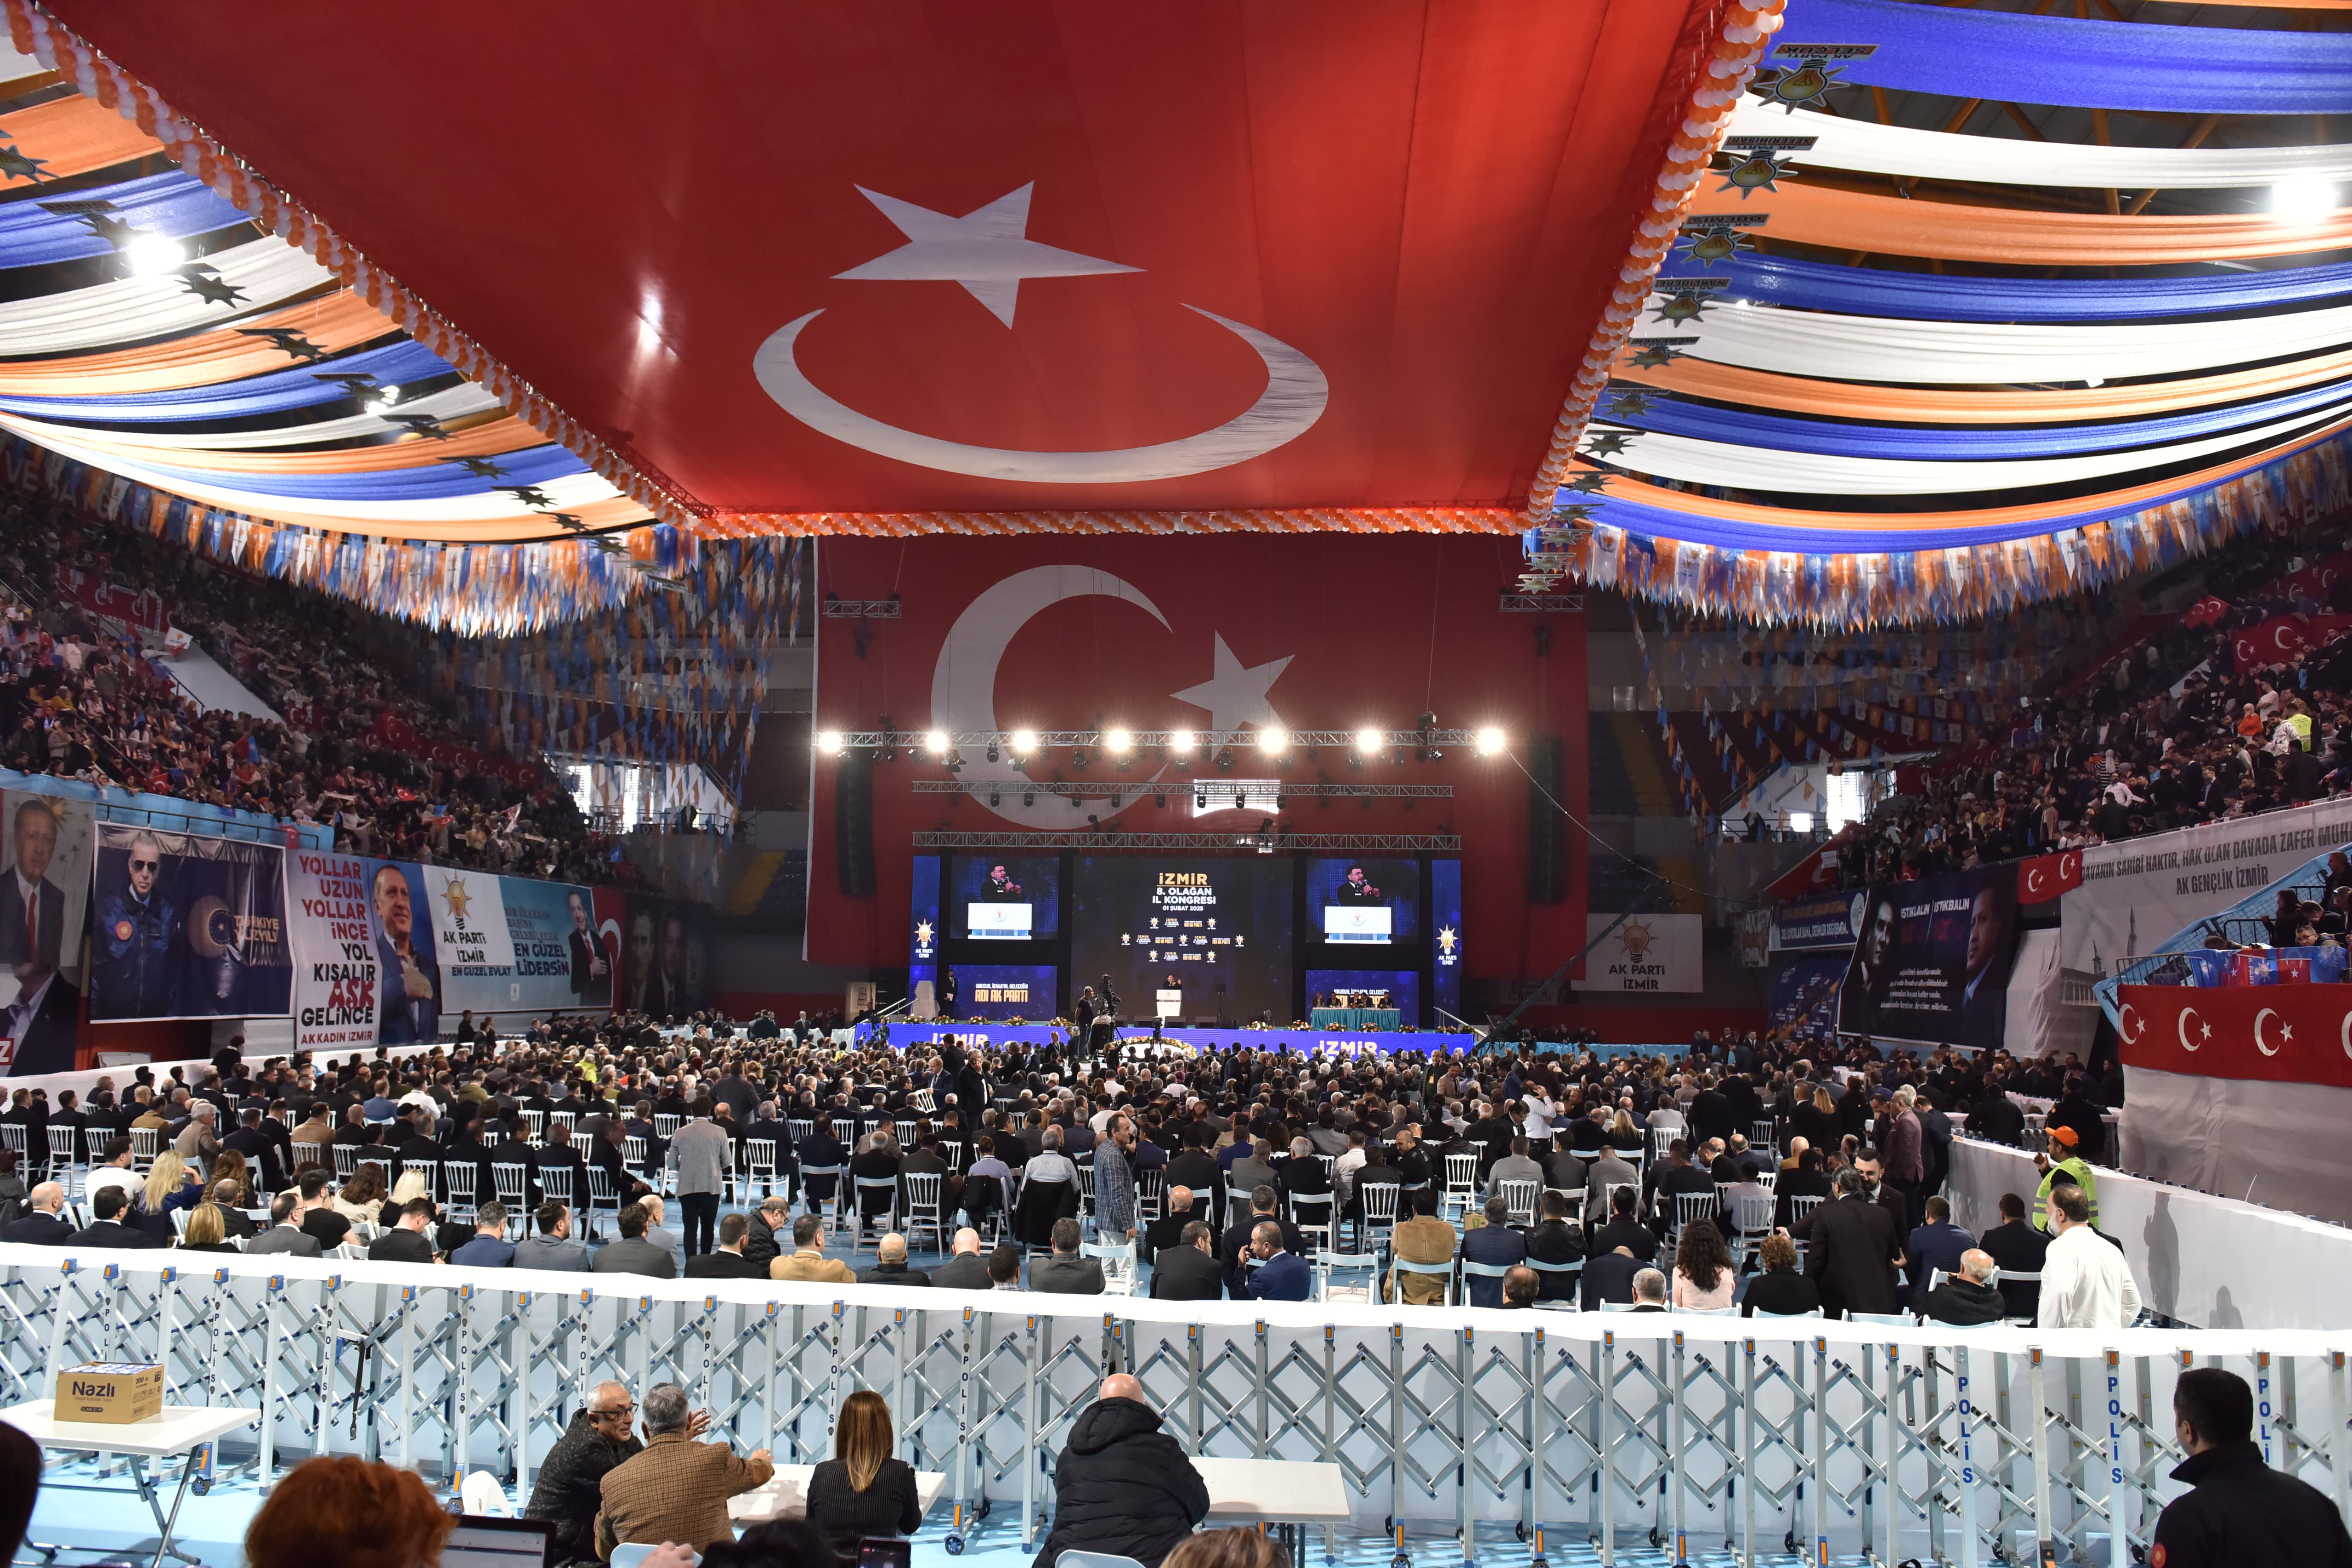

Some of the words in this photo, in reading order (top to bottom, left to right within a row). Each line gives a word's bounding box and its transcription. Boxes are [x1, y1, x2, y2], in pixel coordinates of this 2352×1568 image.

[2116, 854, 2143, 877] SAHİBİ
[2146, 851, 2180, 872] HAKTIR,
[2182, 848, 2202, 867] HAK
[2205, 841, 2230, 864] OLAN
[2233, 835, 2277, 859] DAVADA
[2280, 828, 2315, 852] ZAFER
[299, 855, 362, 880] YOLLAR
[1159, 872, 1207, 885] İZMİR
[2177, 877, 2189, 895] AK
[2191, 868, 2233, 894] GENÇLİK
[2236, 863, 2269, 889] İZMİR
[320, 879, 364, 900] UZUN
[1156, 887, 1165, 895] 8.
[1168, 887, 1212, 895] OLAĞAN
[301, 899, 366, 920] YOLLAR
[330, 922, 369, 941] İNCE
[443, 931, 457, 944] AK
[458, 932, 486, 944] PARTİ
[340, 943, 374, 961] YOL
[456, 946, 486, 962] İZMİR
[514, 943, 530, 957] EN
[532, 940, 567, 958] GÜZEL
[313, 963, 376, 982] KISALIR
[452, 967, 462, 976] EN
[488, 967, 511, 976] EVLAT
[516, 958, 570, 976] LİDERSİN
[1609, 964, 1627, 974] AK
[1631, 965, 1665, 975] PARTİ
[1623, 977, 1659, 990] İZMİR
[990, 989, 1002, 1002] AK
[301, 1006, 374, 1027] GELİNCE
[301, 1034, 315, 1045] AK
[317, 1032, 346, 1044] KADIN
[348, 1030, 373, 1042] İZMİR
[72, 1381, 115, 1397] Nazlı
[1958, 1376, 1973, 1484] POLİS
[2108, 1376, 2122, 1484] POLİS
